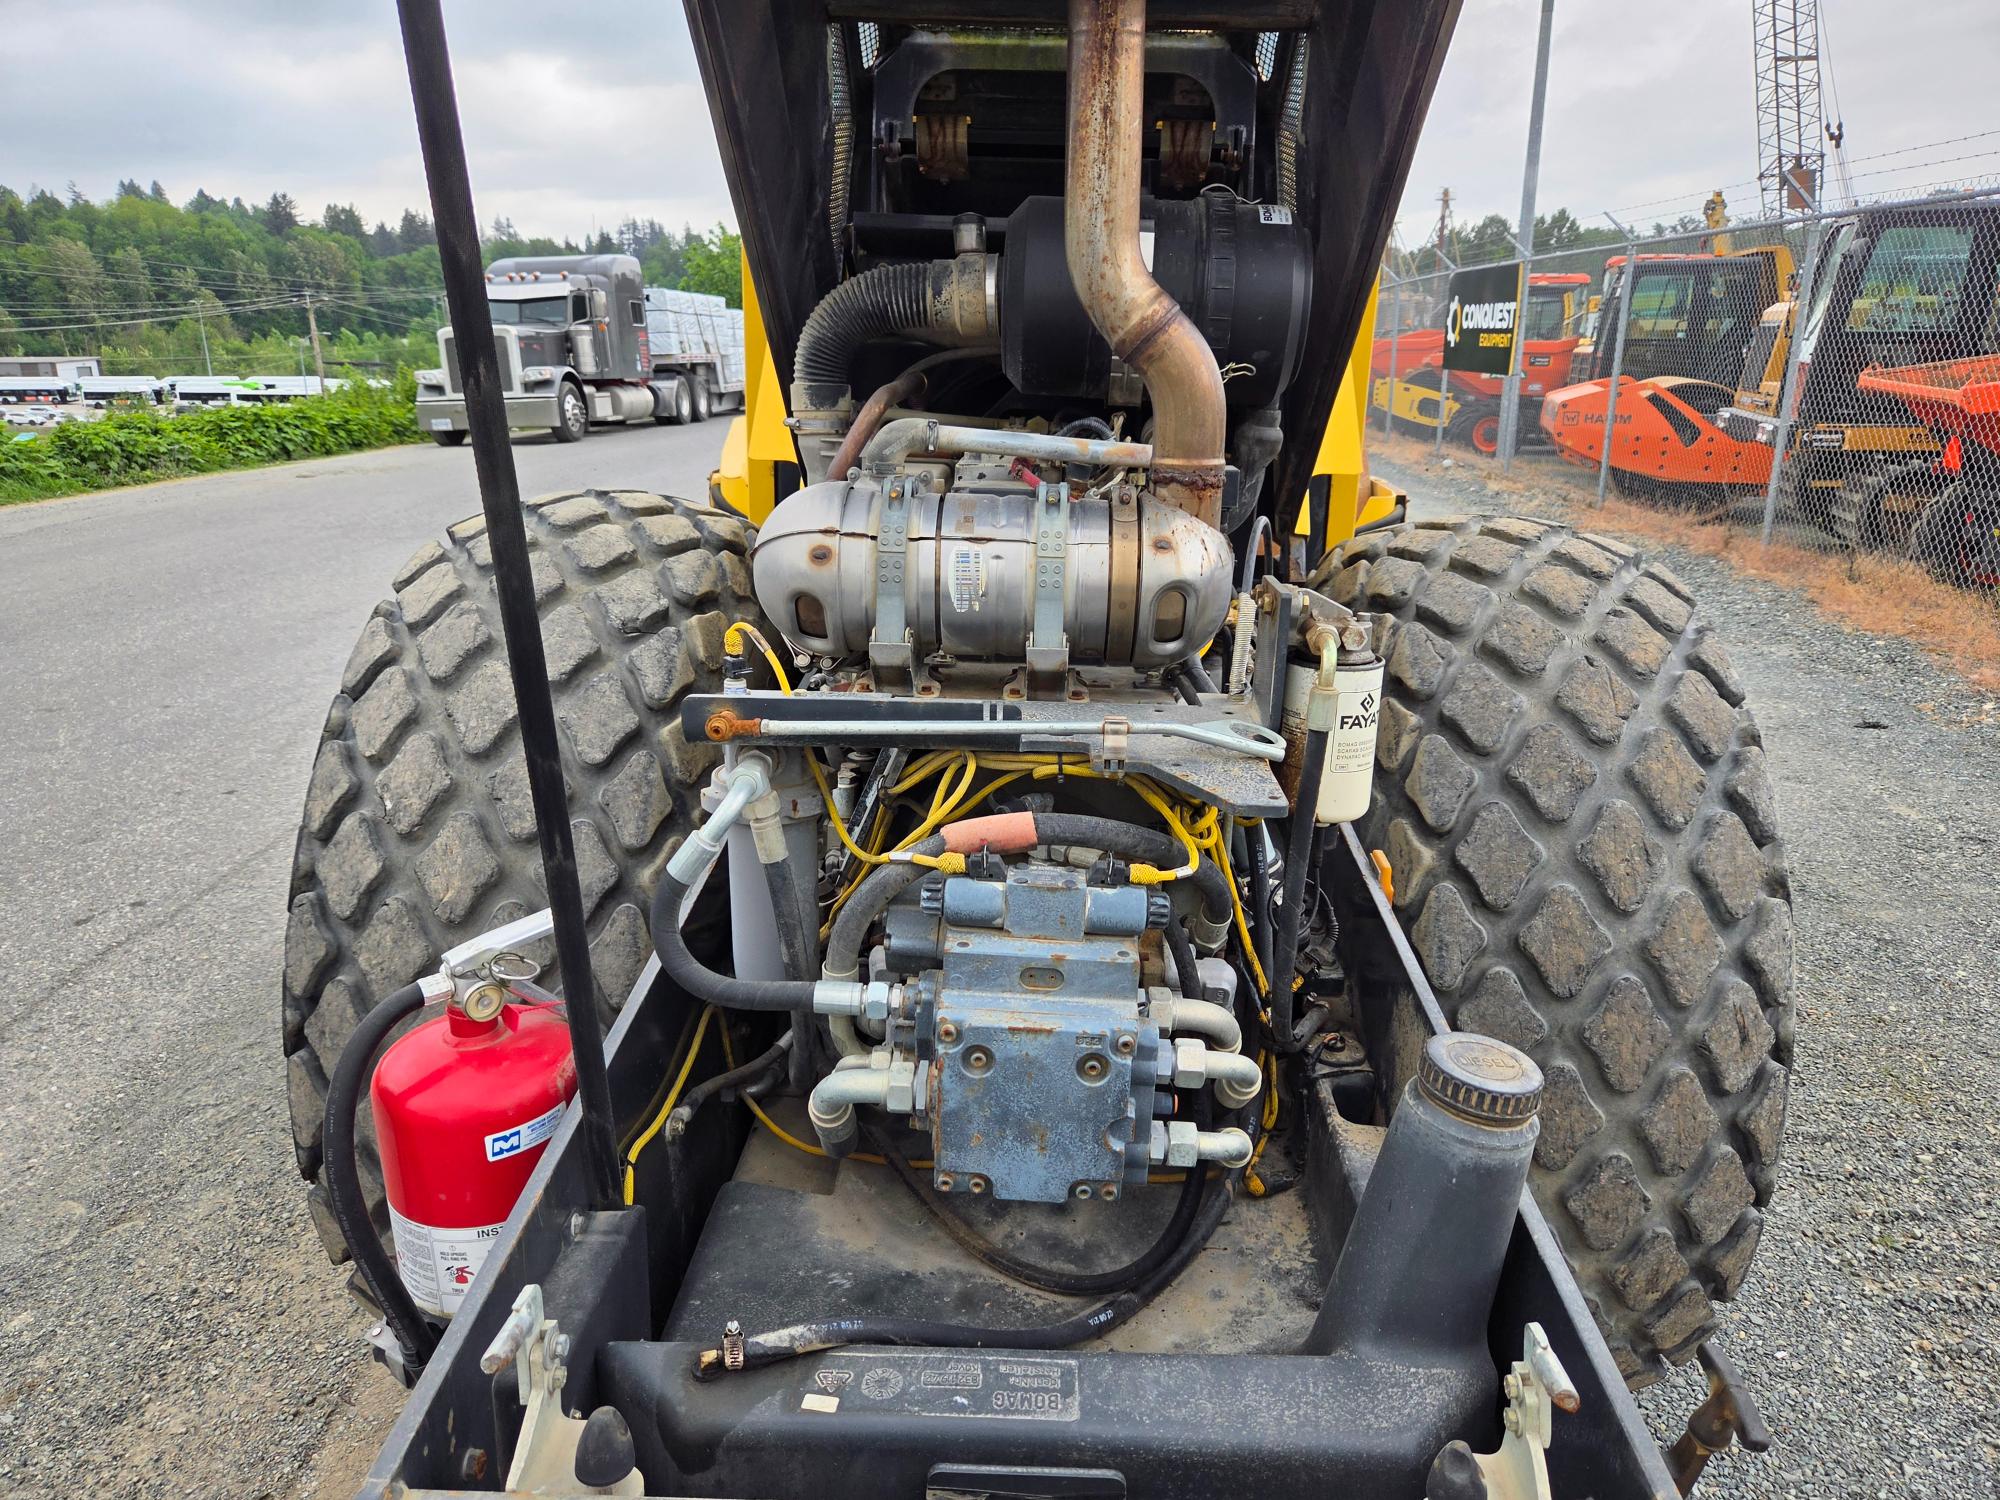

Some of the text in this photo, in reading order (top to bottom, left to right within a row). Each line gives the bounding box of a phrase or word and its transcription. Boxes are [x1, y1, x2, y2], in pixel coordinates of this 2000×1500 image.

[1262, 205, 1273, 222] BOMA
[1462, 301, 1517, 329] CONQUEST
[1479, 333, 1512, 347] EQUIPMENT
[1455, 1055, 1515, 1069] DIESEL
[993, 1391, 1061, 1410] BOMAG
